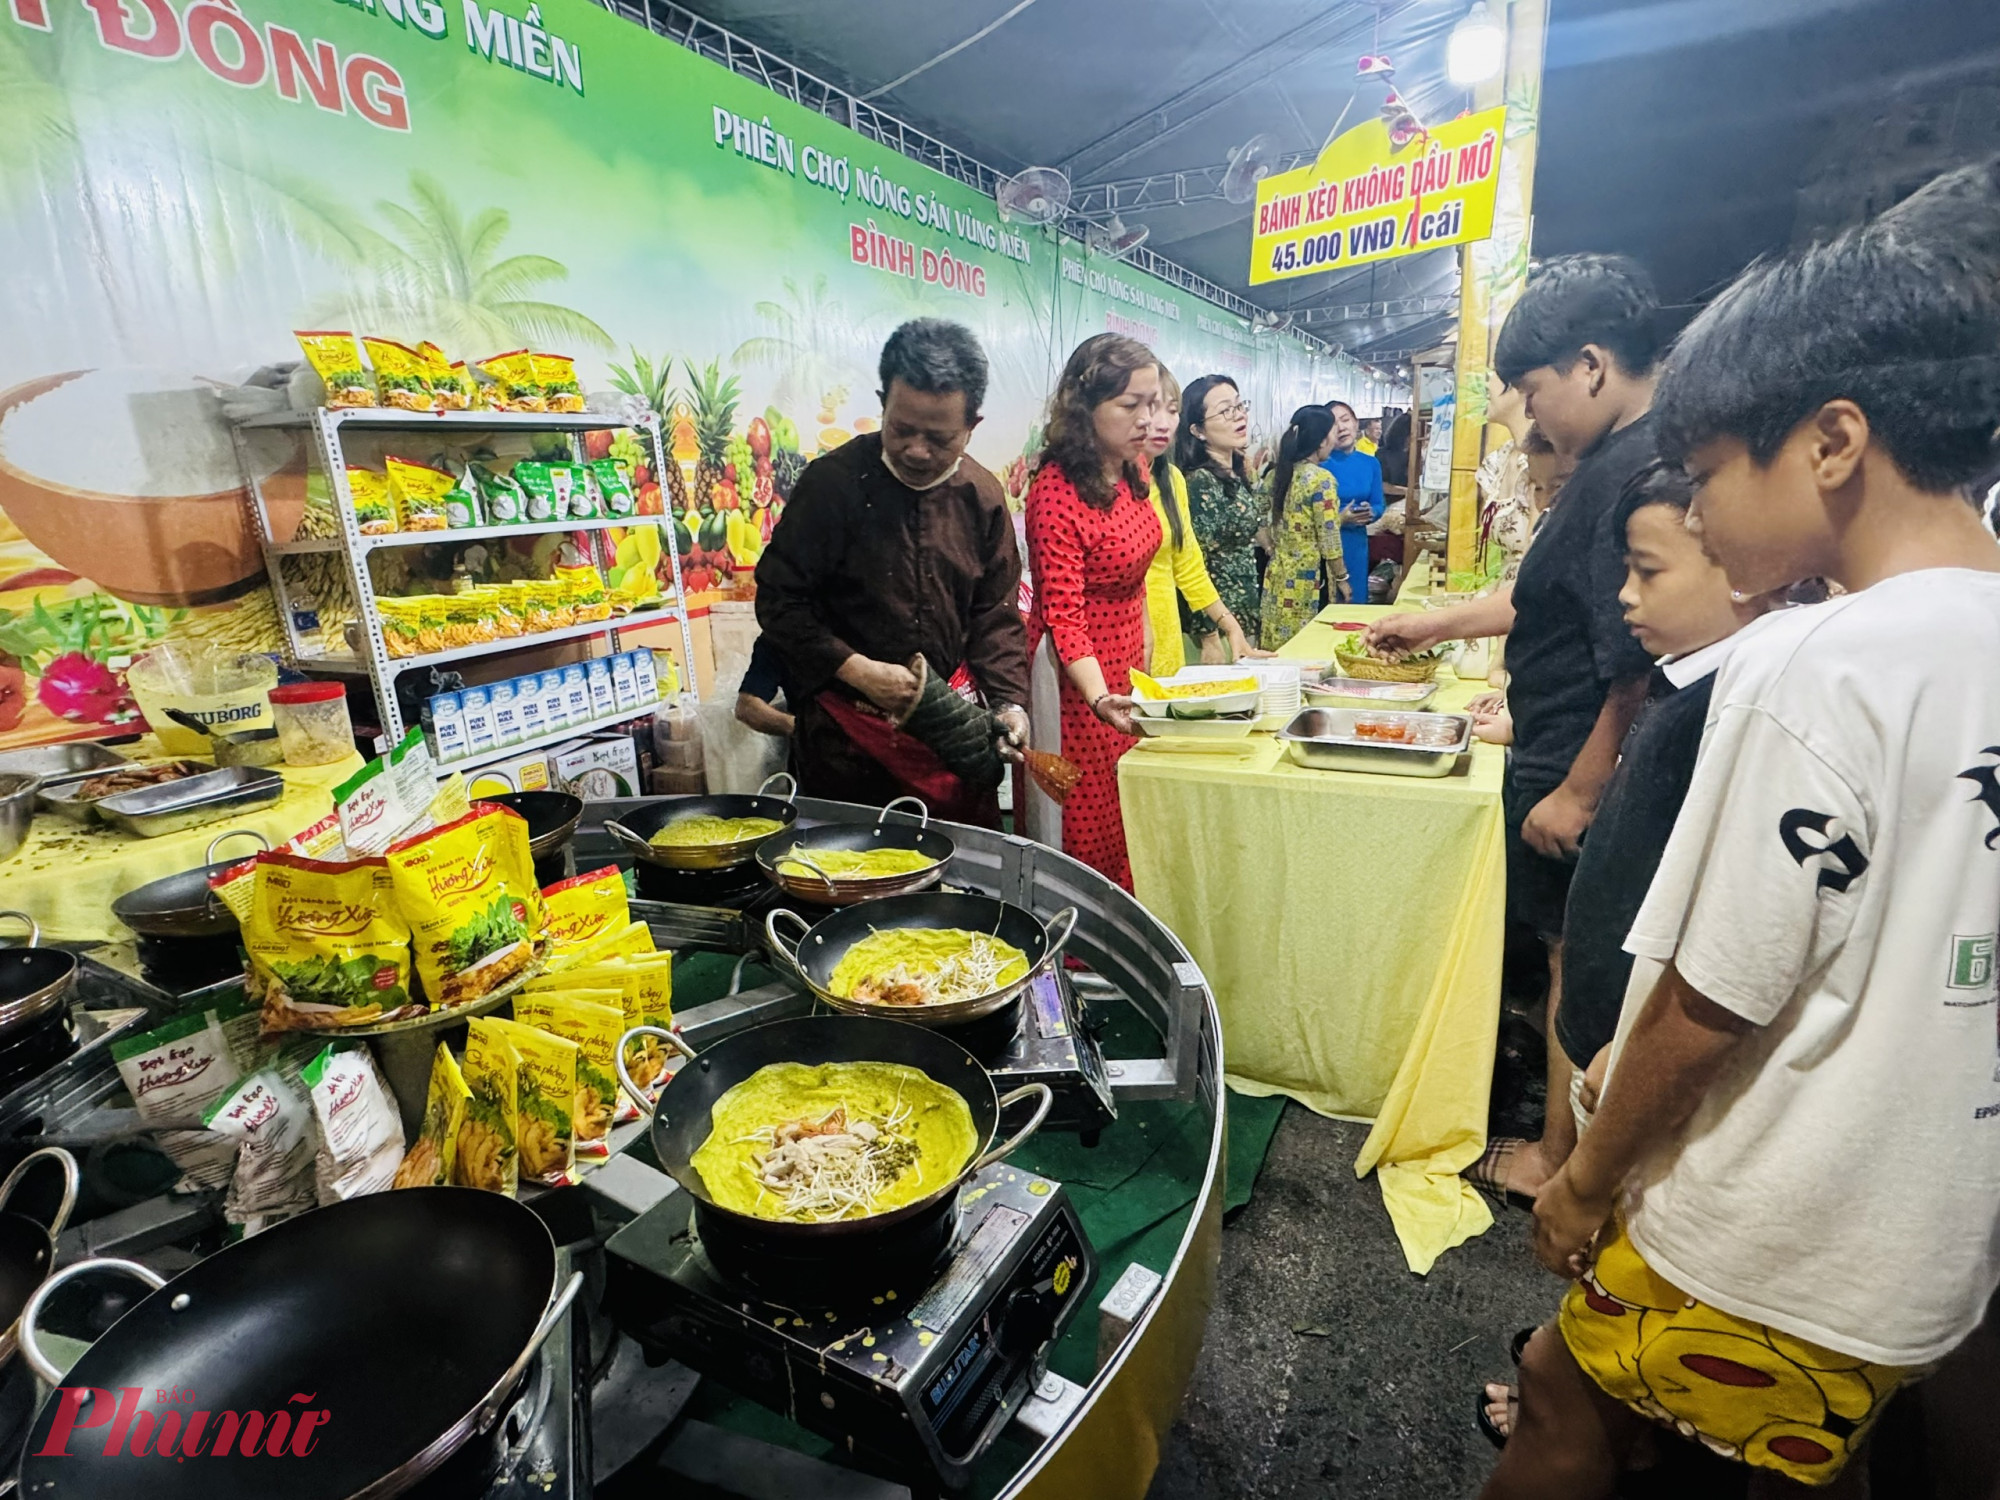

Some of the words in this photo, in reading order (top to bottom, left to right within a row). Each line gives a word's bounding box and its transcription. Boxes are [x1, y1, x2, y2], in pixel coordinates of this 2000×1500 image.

[462, 0, 585, 96] MIỀN
[713, 105, 795, 177] PHIÊN
[801, 146, 849, 201] CHỢ
[855, 166, 911, 216] NÔNG
[915, 190, 951, 234] SẢN
[955, 207, 996, 251] VÙNG
[999, 226, 1031, 266] MIỀN
[1258, 194, 1302, 236] BÁNH
[1304, 182, 1339, 225] XÈO
[1342, 163, 1405, 214] KHÔNG
[1409, 142, 1452, 198] DẦU
[1456, 132, 1497, 185] MỠ
[1271, 231, 1342, 272] 45.000
[1349, 218, 1396, 257] VNĐ
[1420, 202, 1461, 242] cái
[850, 218, 915, 280] BÌNH
[921, 247, 986, 298] ĐÔNG
[497, 710, 512, 718] PURE
[498, 715, 514, 723] MILK
[469, 716, 485, 725] PURE
[439, 723, 455, 733] PURE
[470, 722, 486, 731] MILK
[440, 729, 457, 739] MILK
